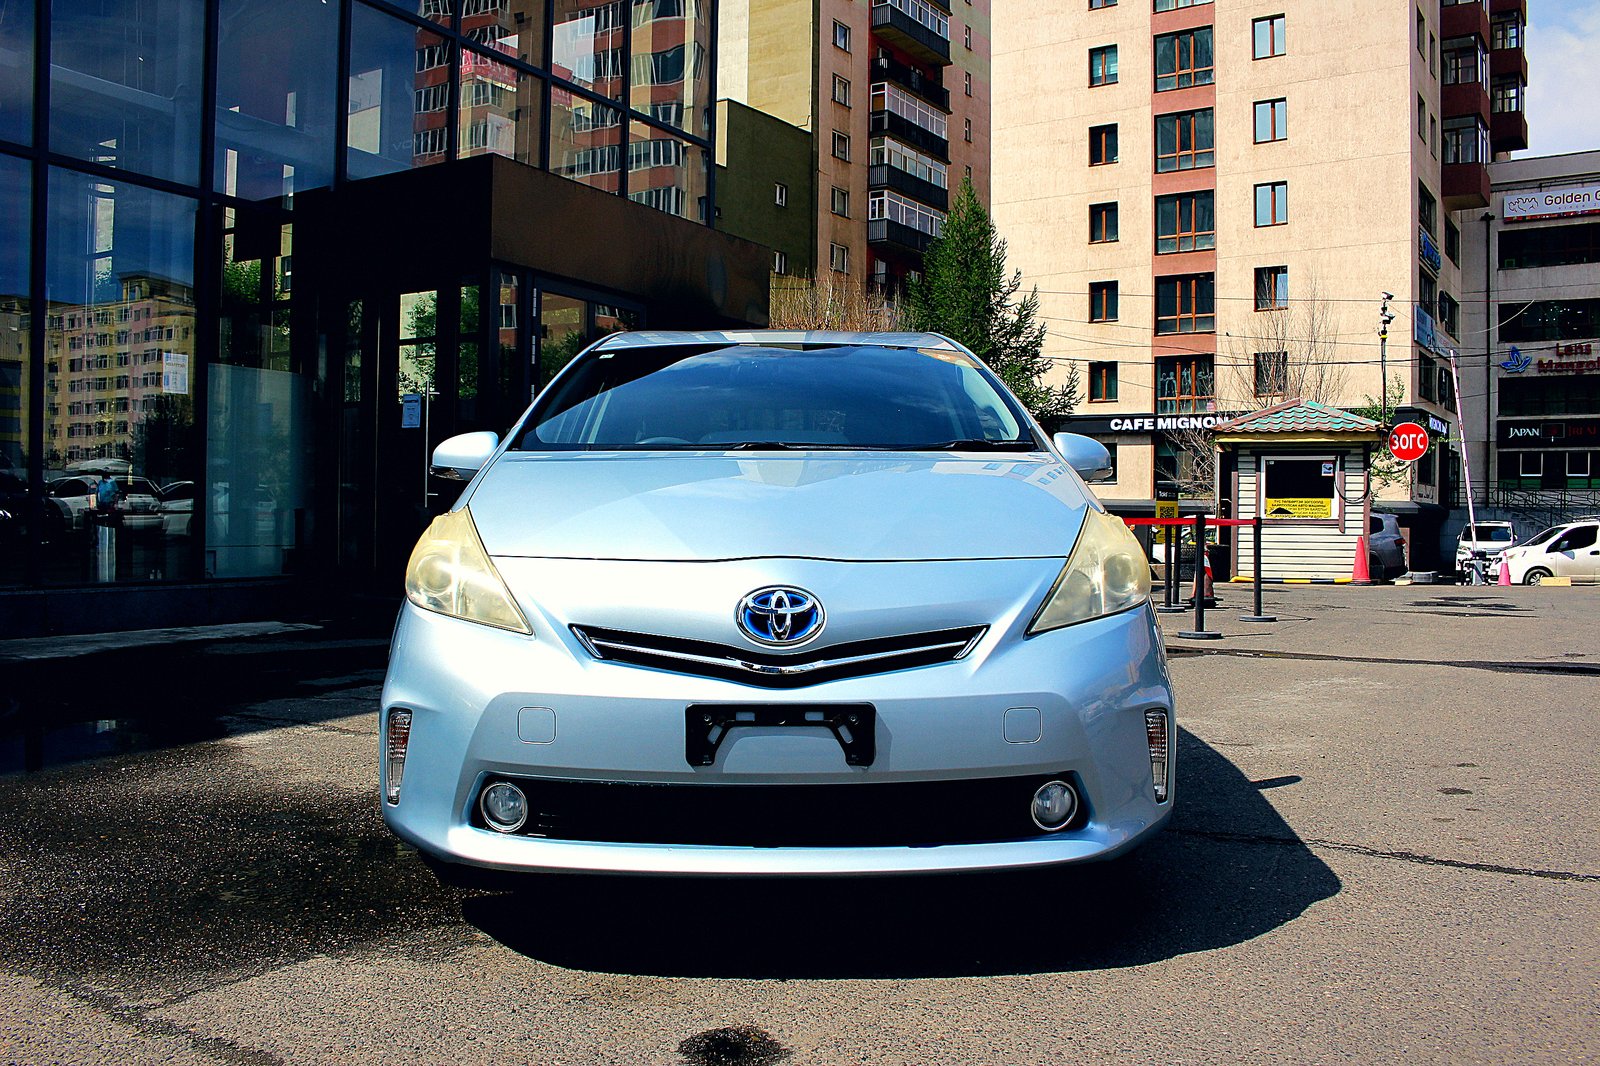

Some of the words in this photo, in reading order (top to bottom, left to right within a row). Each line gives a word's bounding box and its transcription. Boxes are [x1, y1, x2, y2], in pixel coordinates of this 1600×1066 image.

[1544, 193, 1591, 206] Golden
[1556, 342, 1592, 356] Lens
[1110, 418, 1154, 431] CAFE
[1508, 427, 1540, 439] JAPAN
[1391, 433, 1424, 450] ЗОГС
